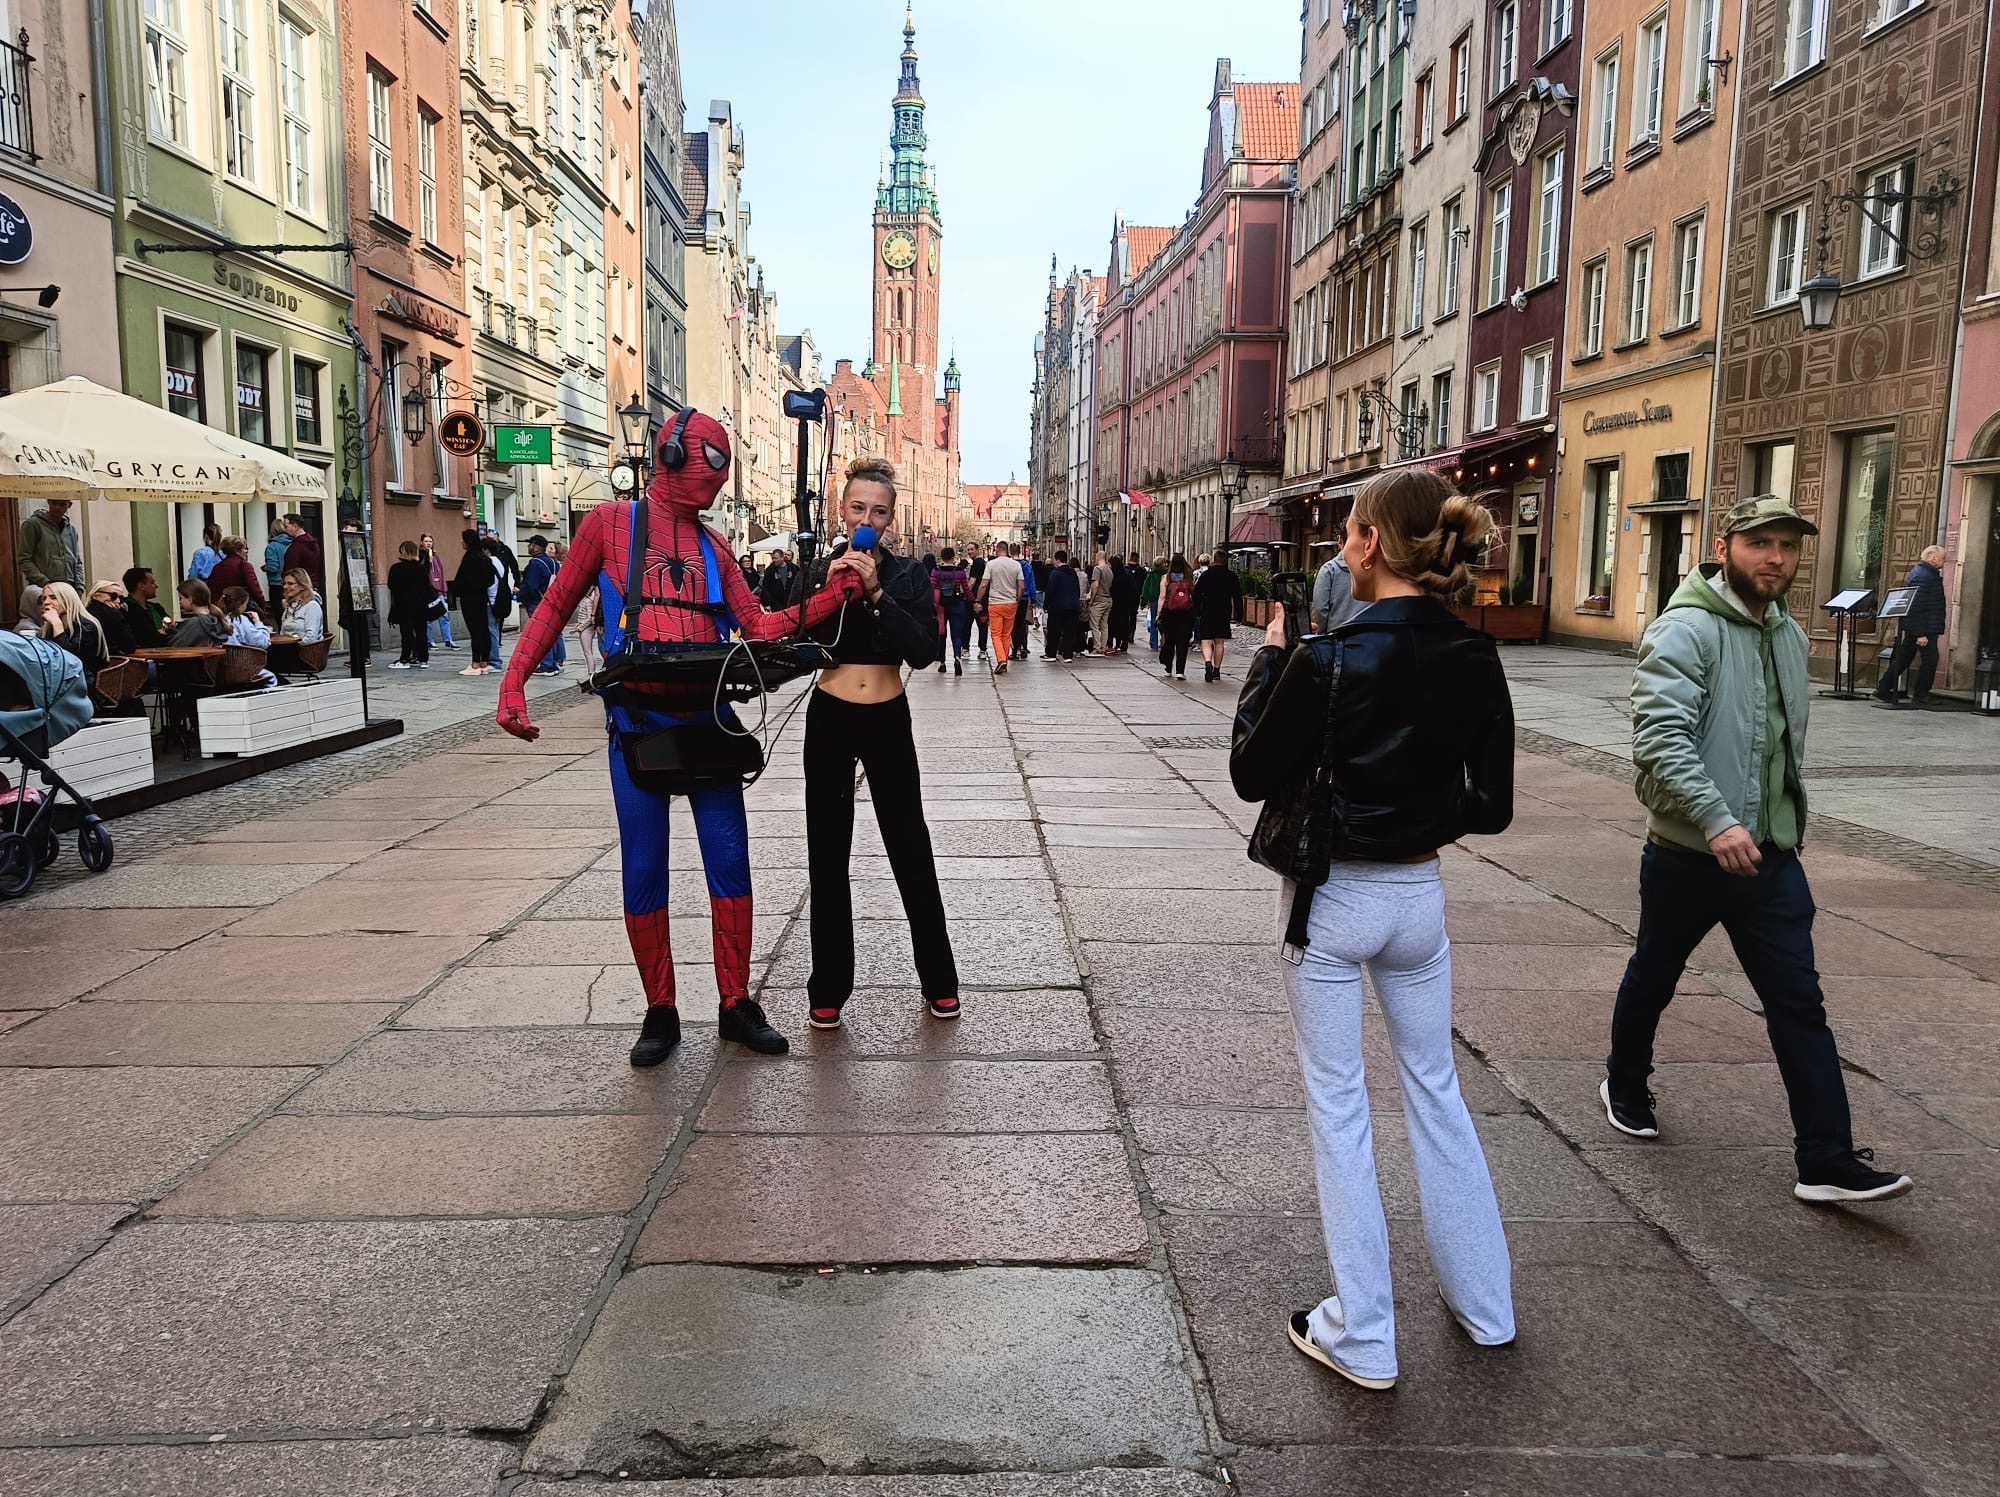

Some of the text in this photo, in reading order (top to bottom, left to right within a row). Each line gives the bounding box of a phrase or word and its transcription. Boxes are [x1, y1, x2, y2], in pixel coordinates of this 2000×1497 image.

[213, 260, 298, 312] Soprano
[445, 436, 475, 445] WINSTON
[16, 445, 89, 472] GRYCAN
[94, 461, 231, 480] GRYCAN
[272, 471, 321, 488] GRYCAN
